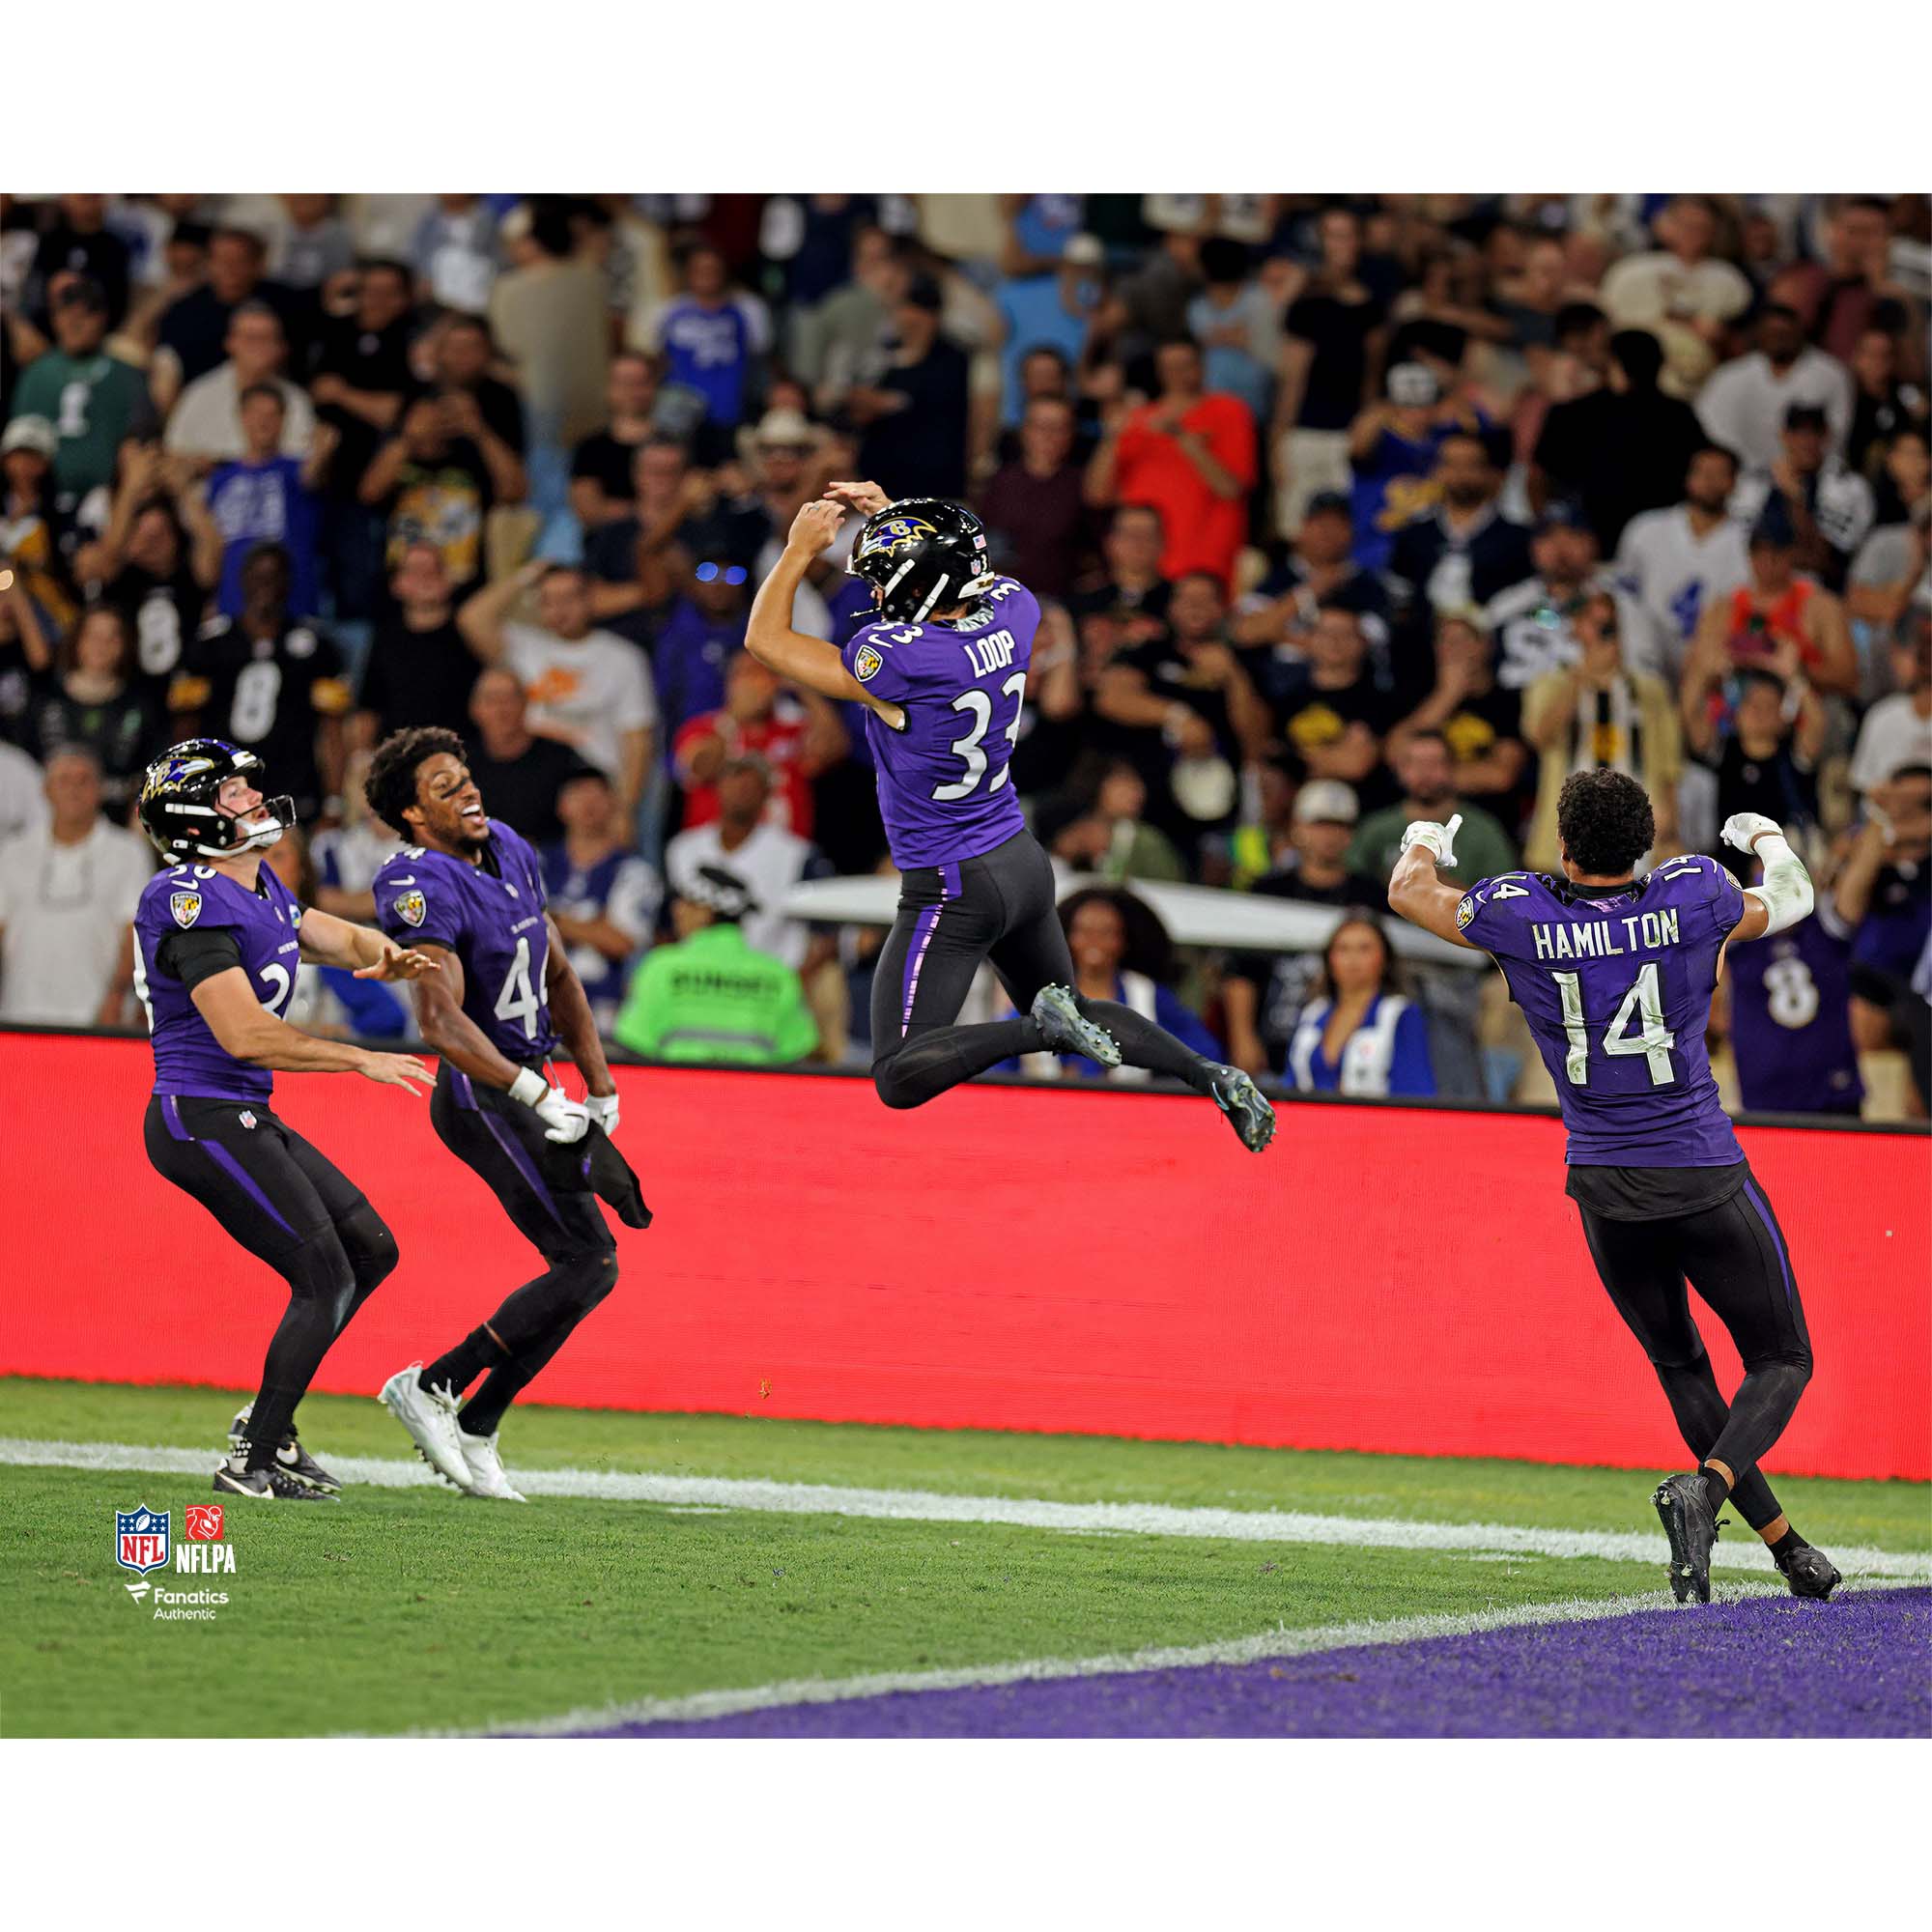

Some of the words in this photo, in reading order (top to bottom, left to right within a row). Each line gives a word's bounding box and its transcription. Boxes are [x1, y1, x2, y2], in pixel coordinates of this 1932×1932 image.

[963, 629, 1016, 679] LOOP
[230, 660, 282, 743] 8
[1490, 874, 1530, 900] 14
[1531, 908, 1680, 960] HAMILTON
[258, 956, 301, 1022] 2
[1762, 958, 1820, 1029] 8
[1550, 962, 1676, 1086] 14
